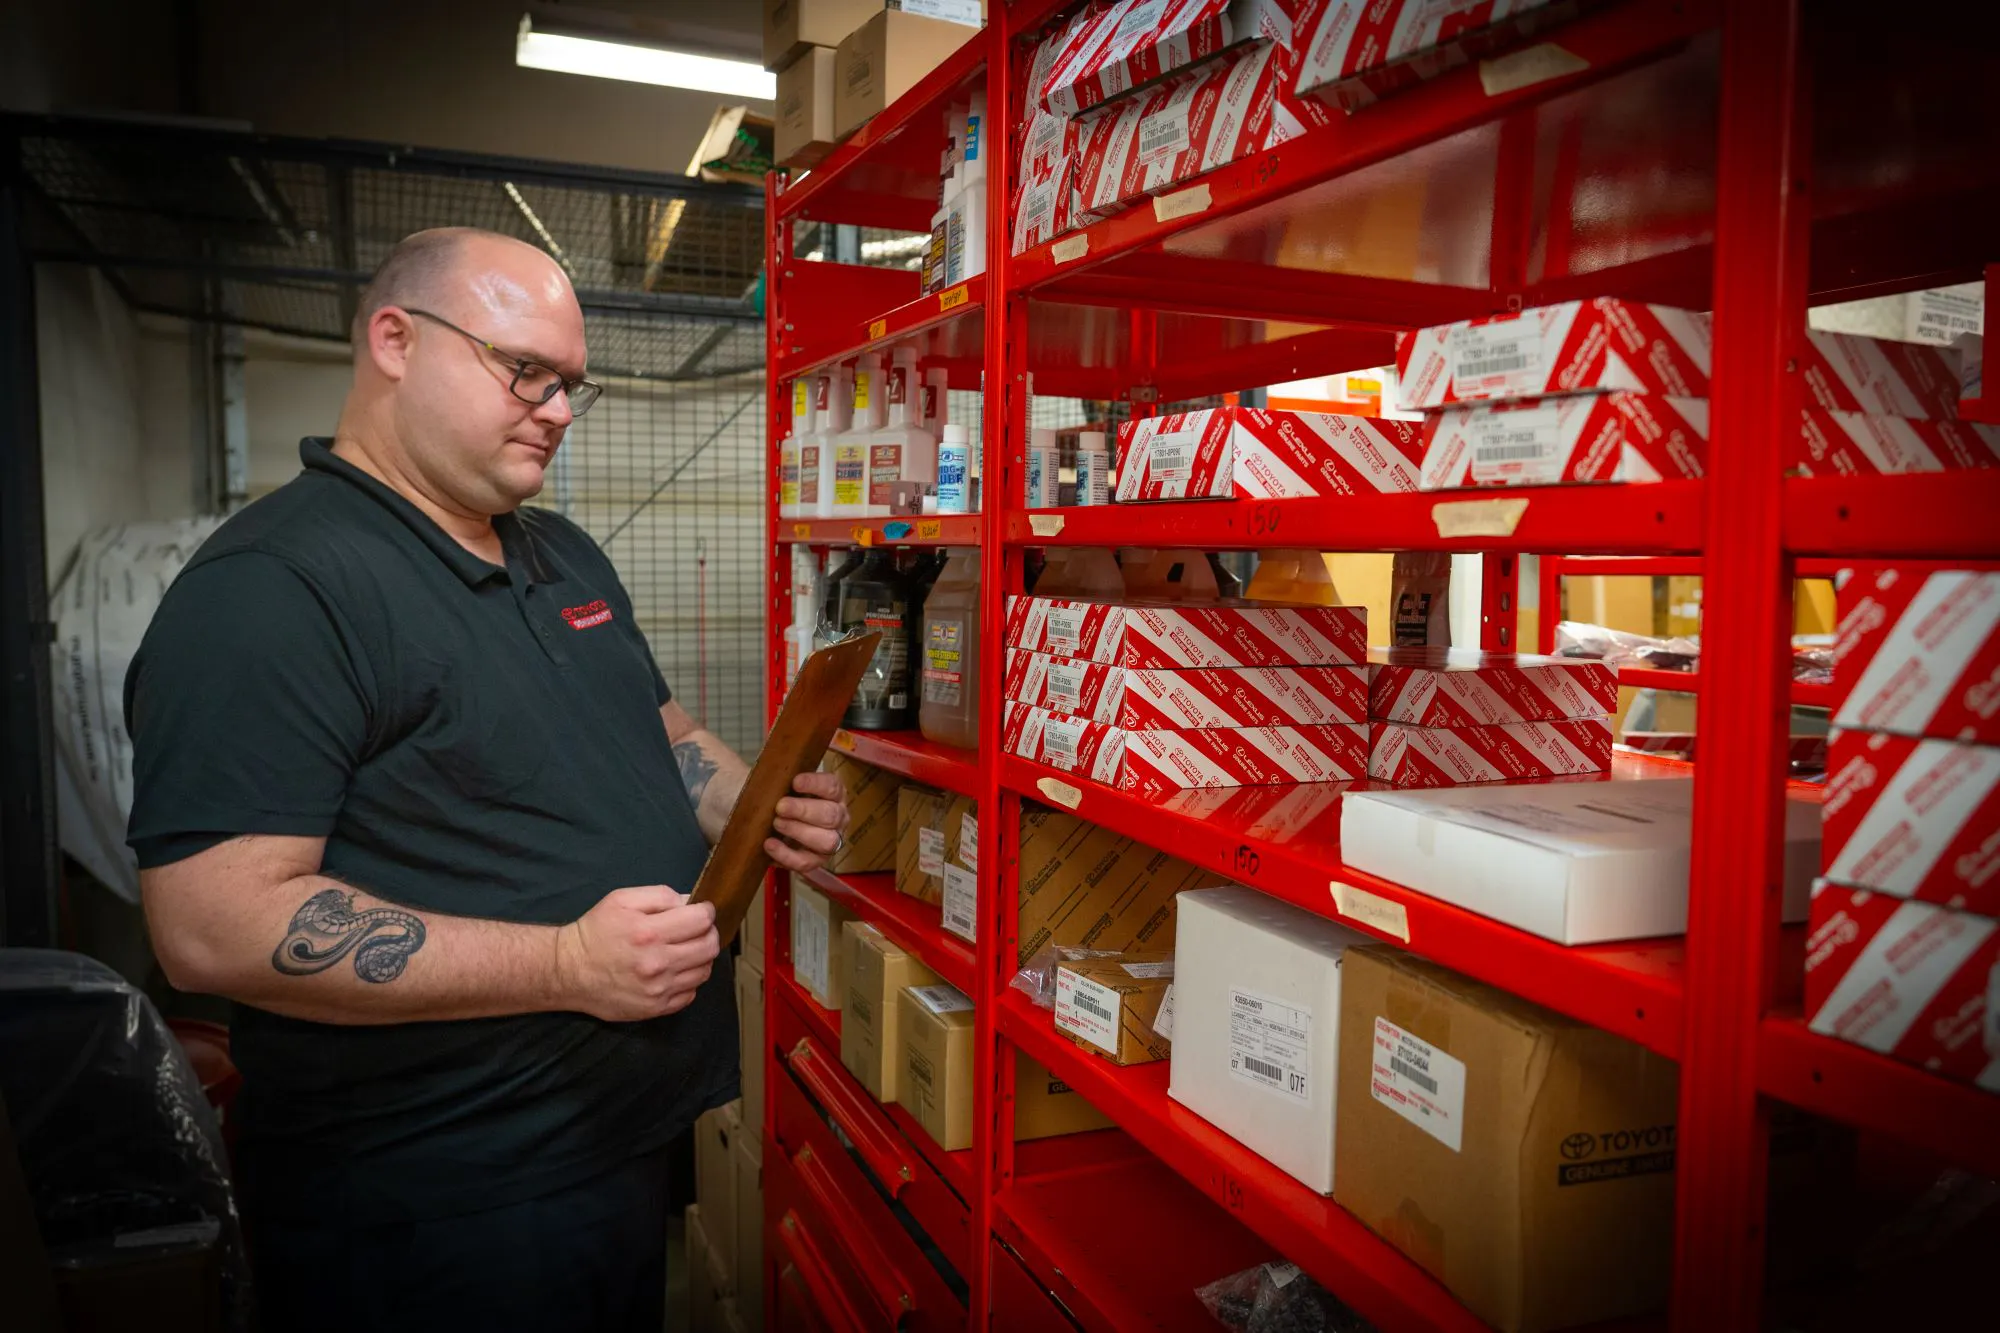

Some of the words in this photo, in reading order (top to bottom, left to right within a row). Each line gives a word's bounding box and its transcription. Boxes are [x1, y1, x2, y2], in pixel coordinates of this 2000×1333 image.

[1291, 431, 1317, 464] LEXUS
[1349, 433, 1373, 463] TOYOTA
[1262, 464, 1286, 496] TOYOTA
[1246, 505, 1281, 535] 150
[1183, 634, 1205, 660] TOYOTA
[1183, 696, 1204, 722] TOYOTA
[1244, 697, 1265, 721] LEXUS
[1183, 756, 1204, 780] TOYOTA
[1243, 754, 1264, 779] LEXUS
[1233, 846, 1260, 877] 150
[1231, 1059, 1239, 1069] 07
[1290, 1072, 1306, 1095] 07F
[1598, 1124, 1676, 1153] TOYOT
